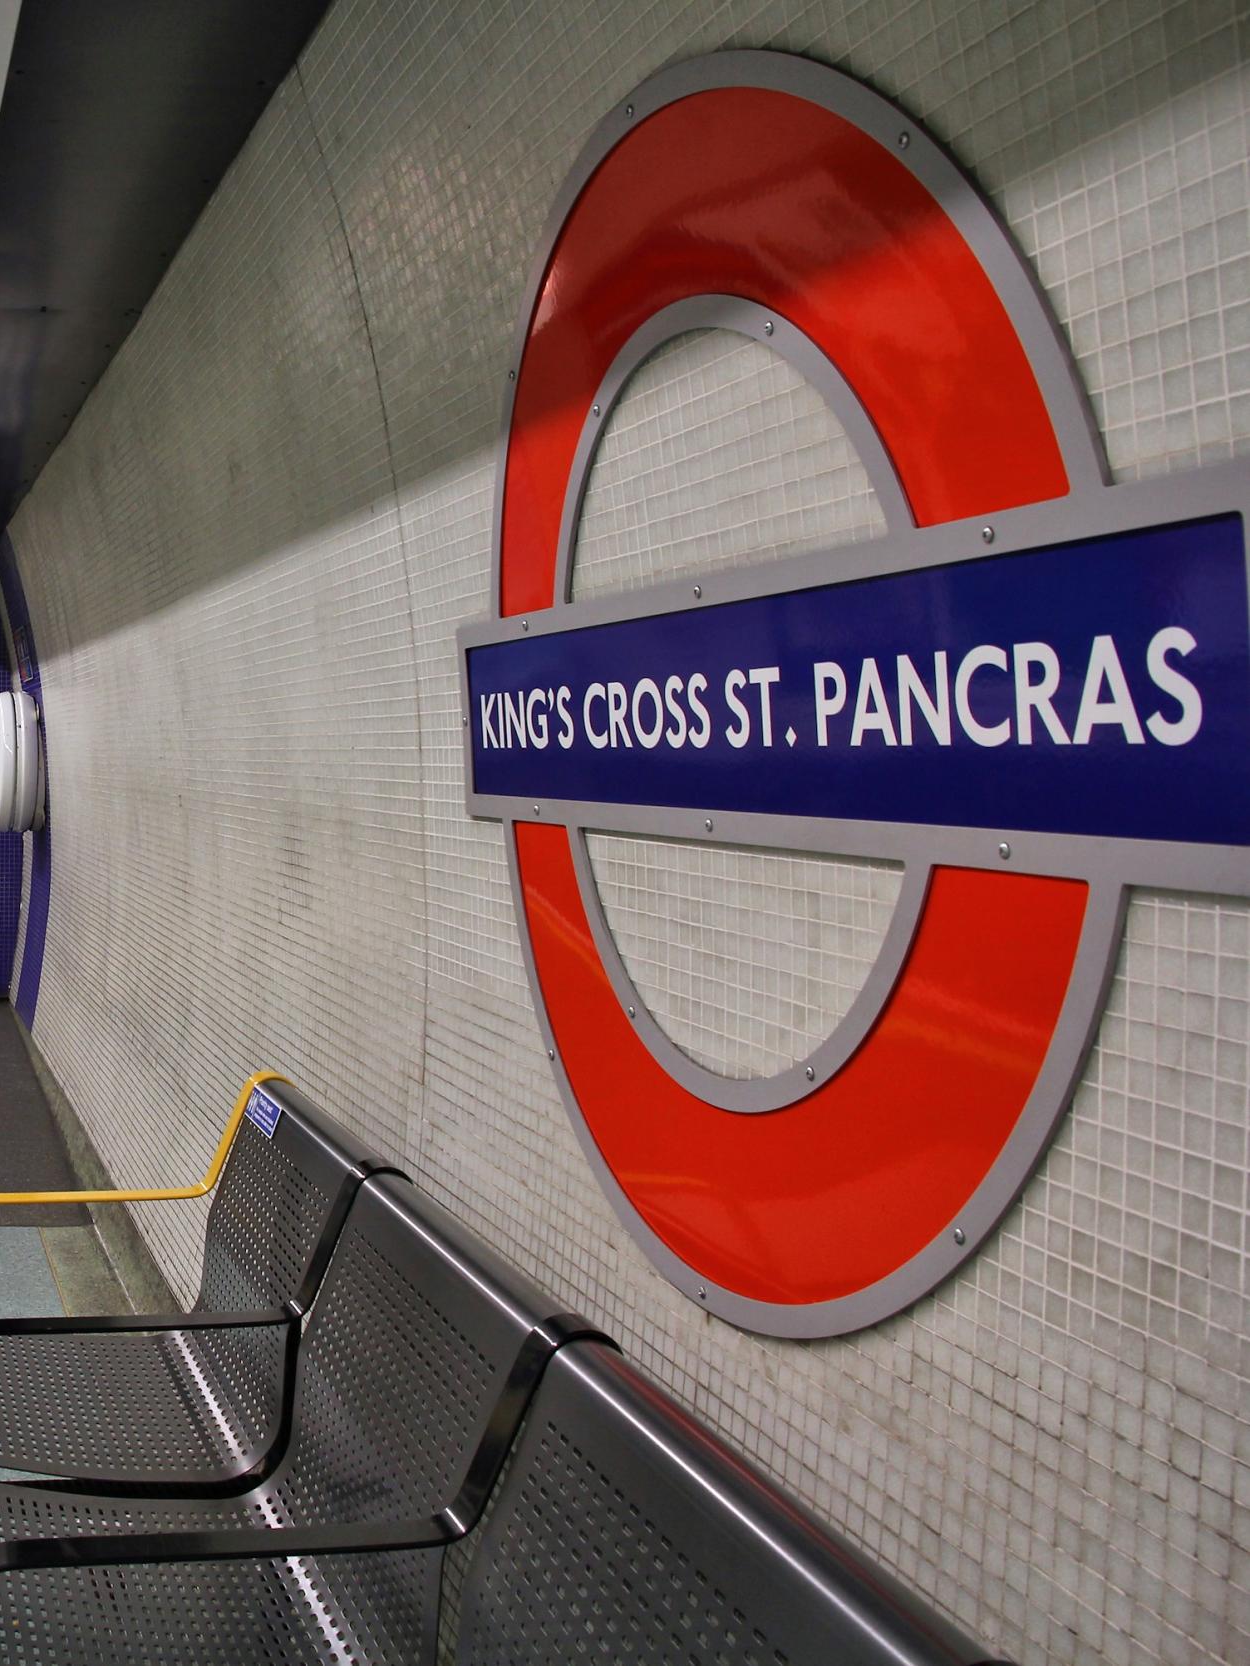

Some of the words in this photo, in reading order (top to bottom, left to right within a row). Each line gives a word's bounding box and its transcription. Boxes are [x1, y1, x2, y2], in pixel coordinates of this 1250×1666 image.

[480, 687, 573, 750] KING'S
[583, 674, 712, 750] CROSS
[724, 667, 797, 749] ST.
[814, 627, 1203, 747] PANCRAS
